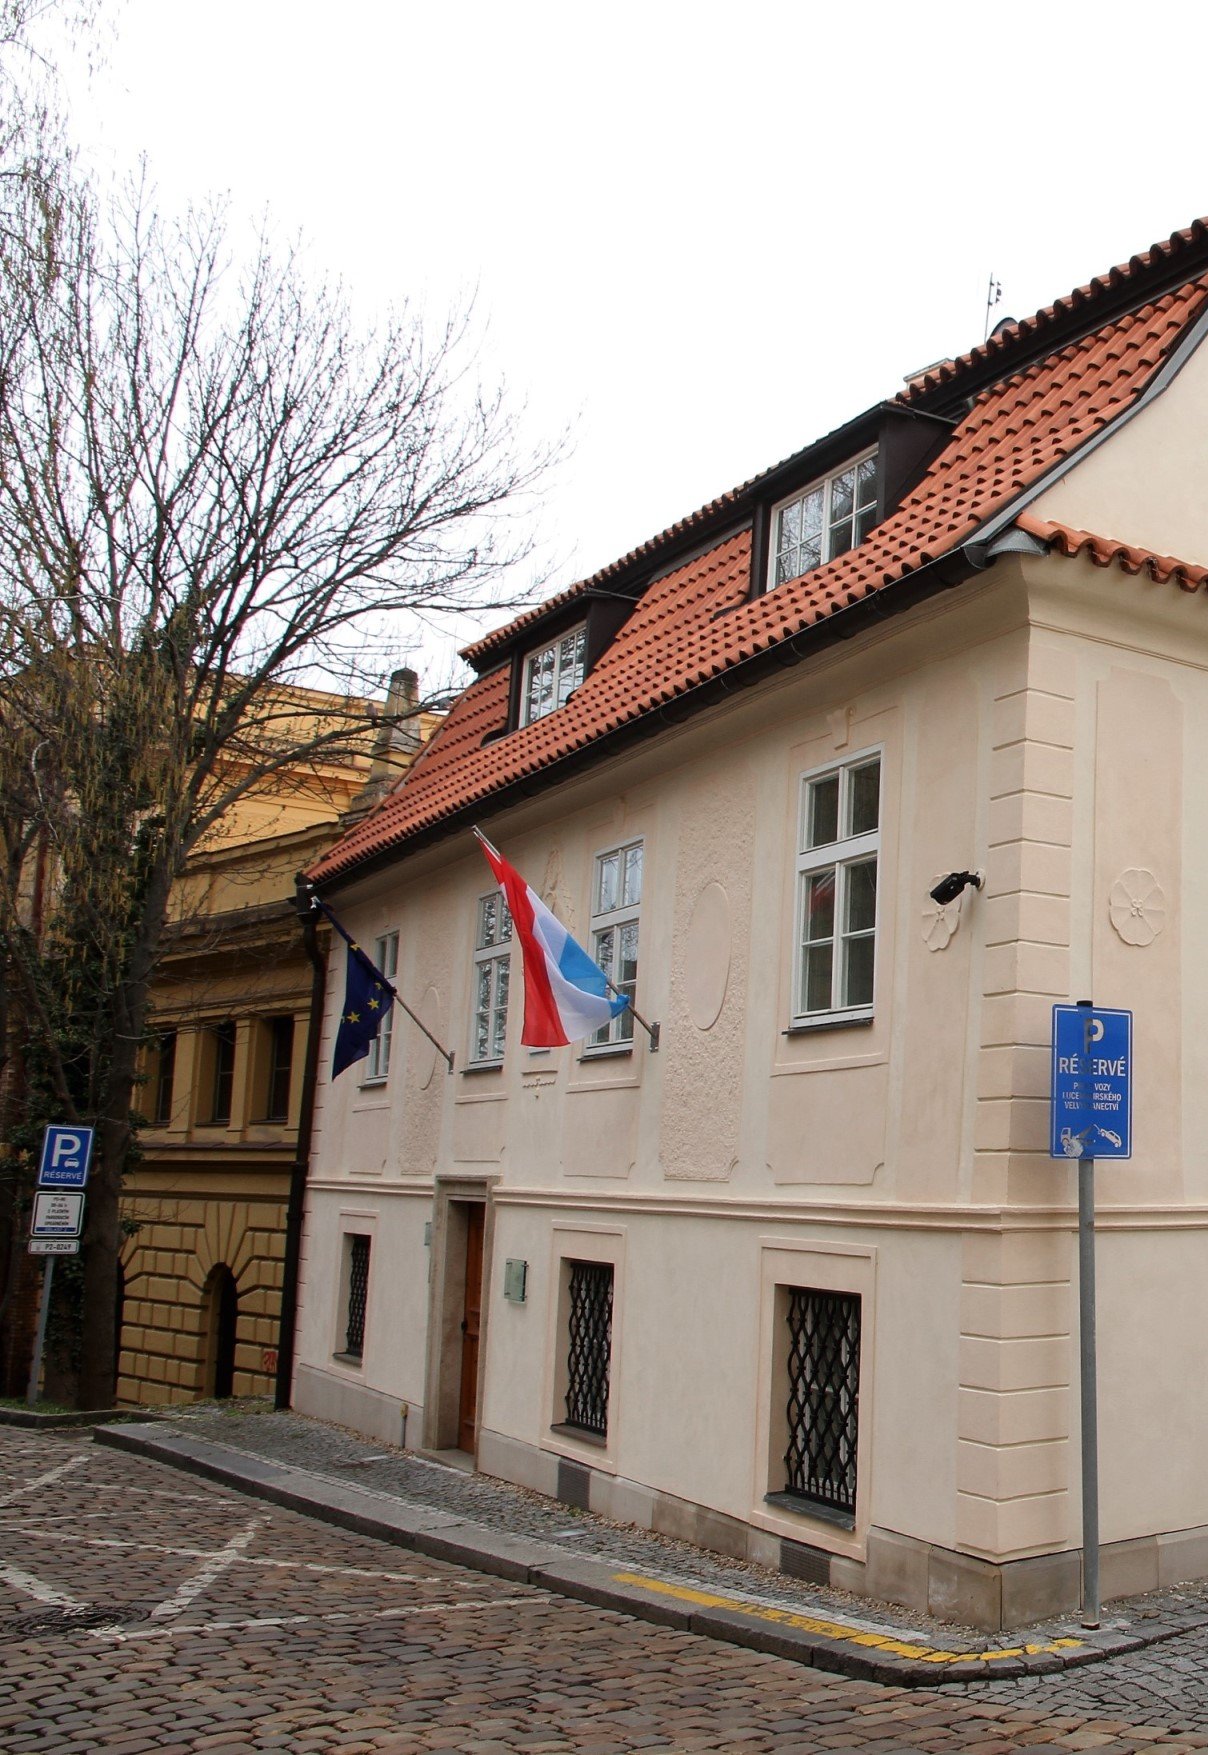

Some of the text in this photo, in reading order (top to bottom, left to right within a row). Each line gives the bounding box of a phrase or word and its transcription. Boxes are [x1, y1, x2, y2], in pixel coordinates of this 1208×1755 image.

[1084, 1018, 1105, 1054] P
[1059, 1054, 1126, 1077] RÉERVÉ
[1094, 1083, 1111, 1091] VOZY
[51, 1133, 81, 1167] P
[43, 1170, 83, 1180] RÉSERVÉ
